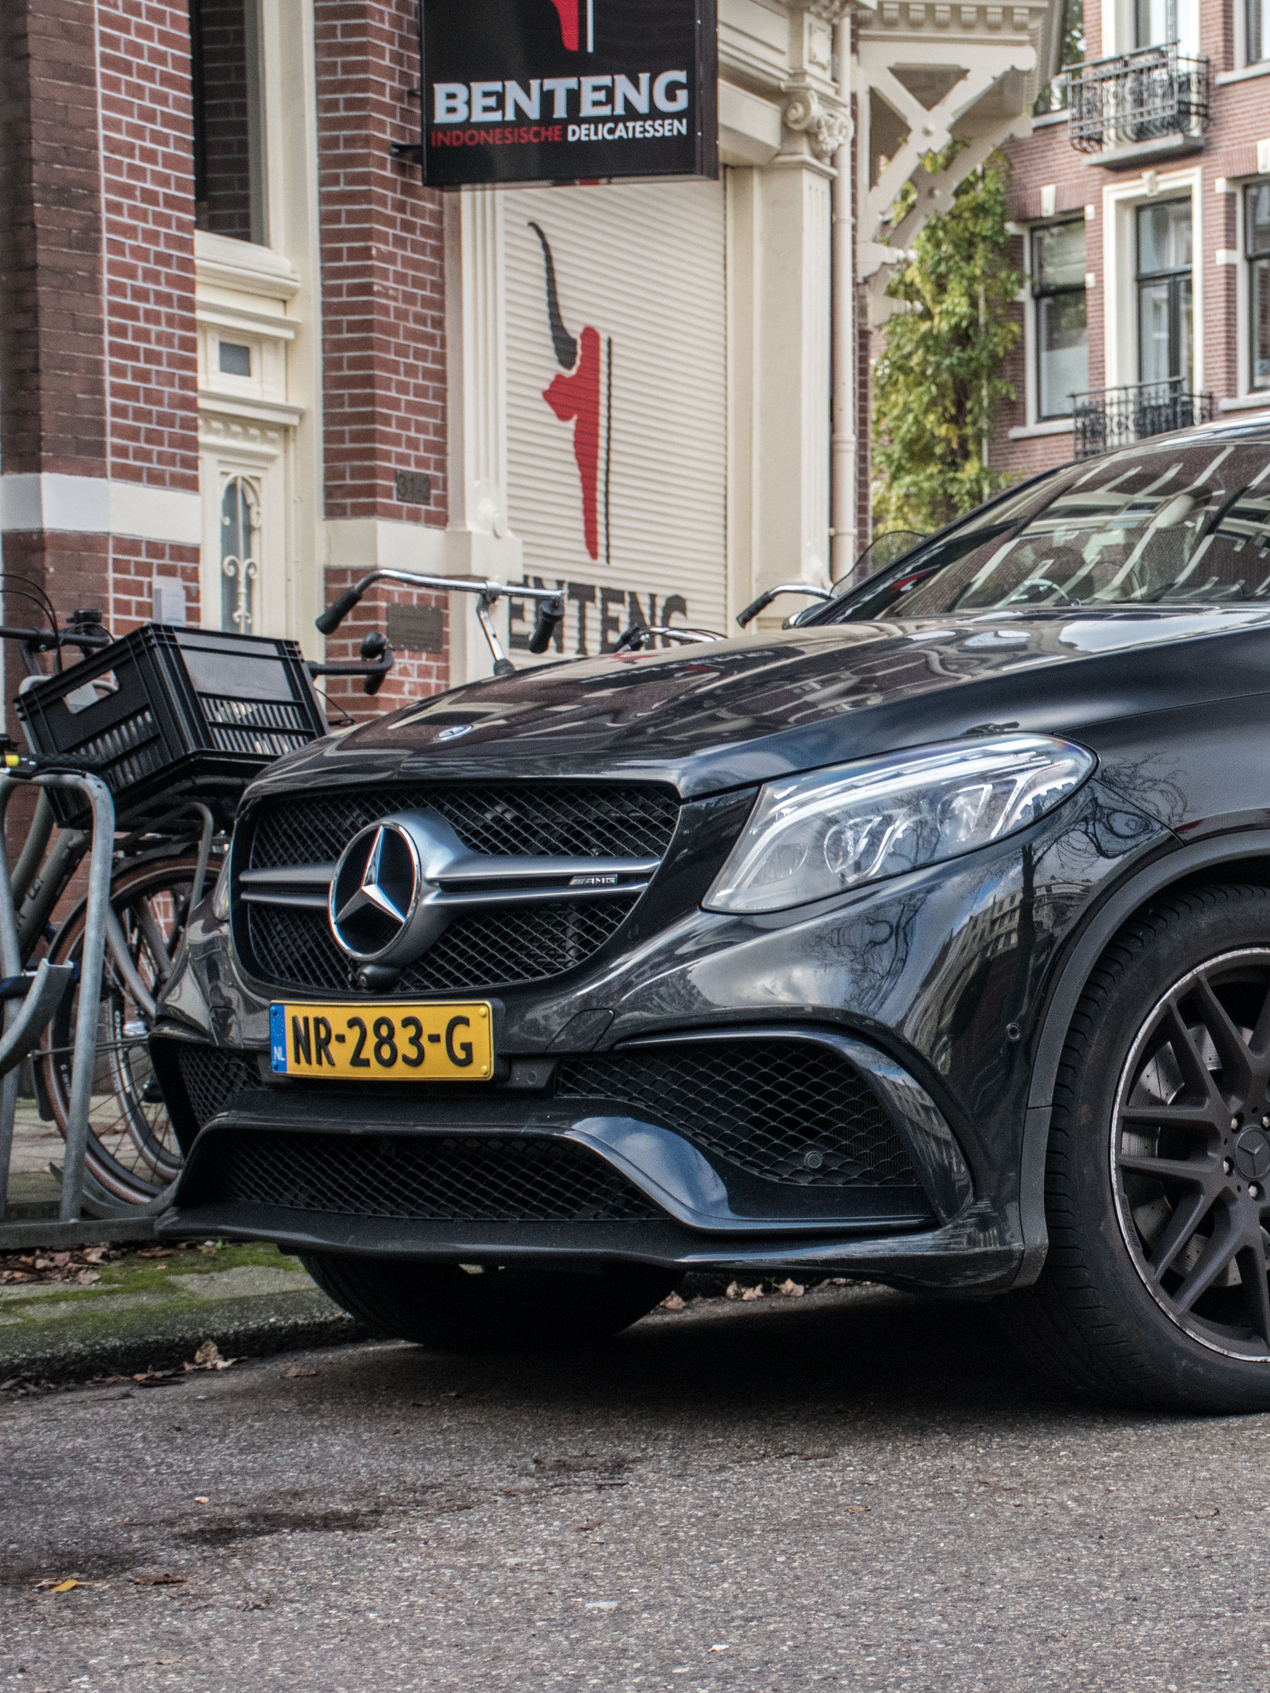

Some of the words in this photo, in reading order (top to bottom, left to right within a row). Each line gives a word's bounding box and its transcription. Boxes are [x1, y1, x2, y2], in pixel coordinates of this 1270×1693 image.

[433, 70, 689, 124] BENTENG
[431, 125, 563, 147] INDONESISCHE
[567, 118, 688, 142] DELICATESSEN
[507, 574, 688, 656] ENTEN
[583, 877, 616, 885] AMG
[273, 1046, 286, 1062] NL
[291, 1015, 474, 1068] NR-283-G
